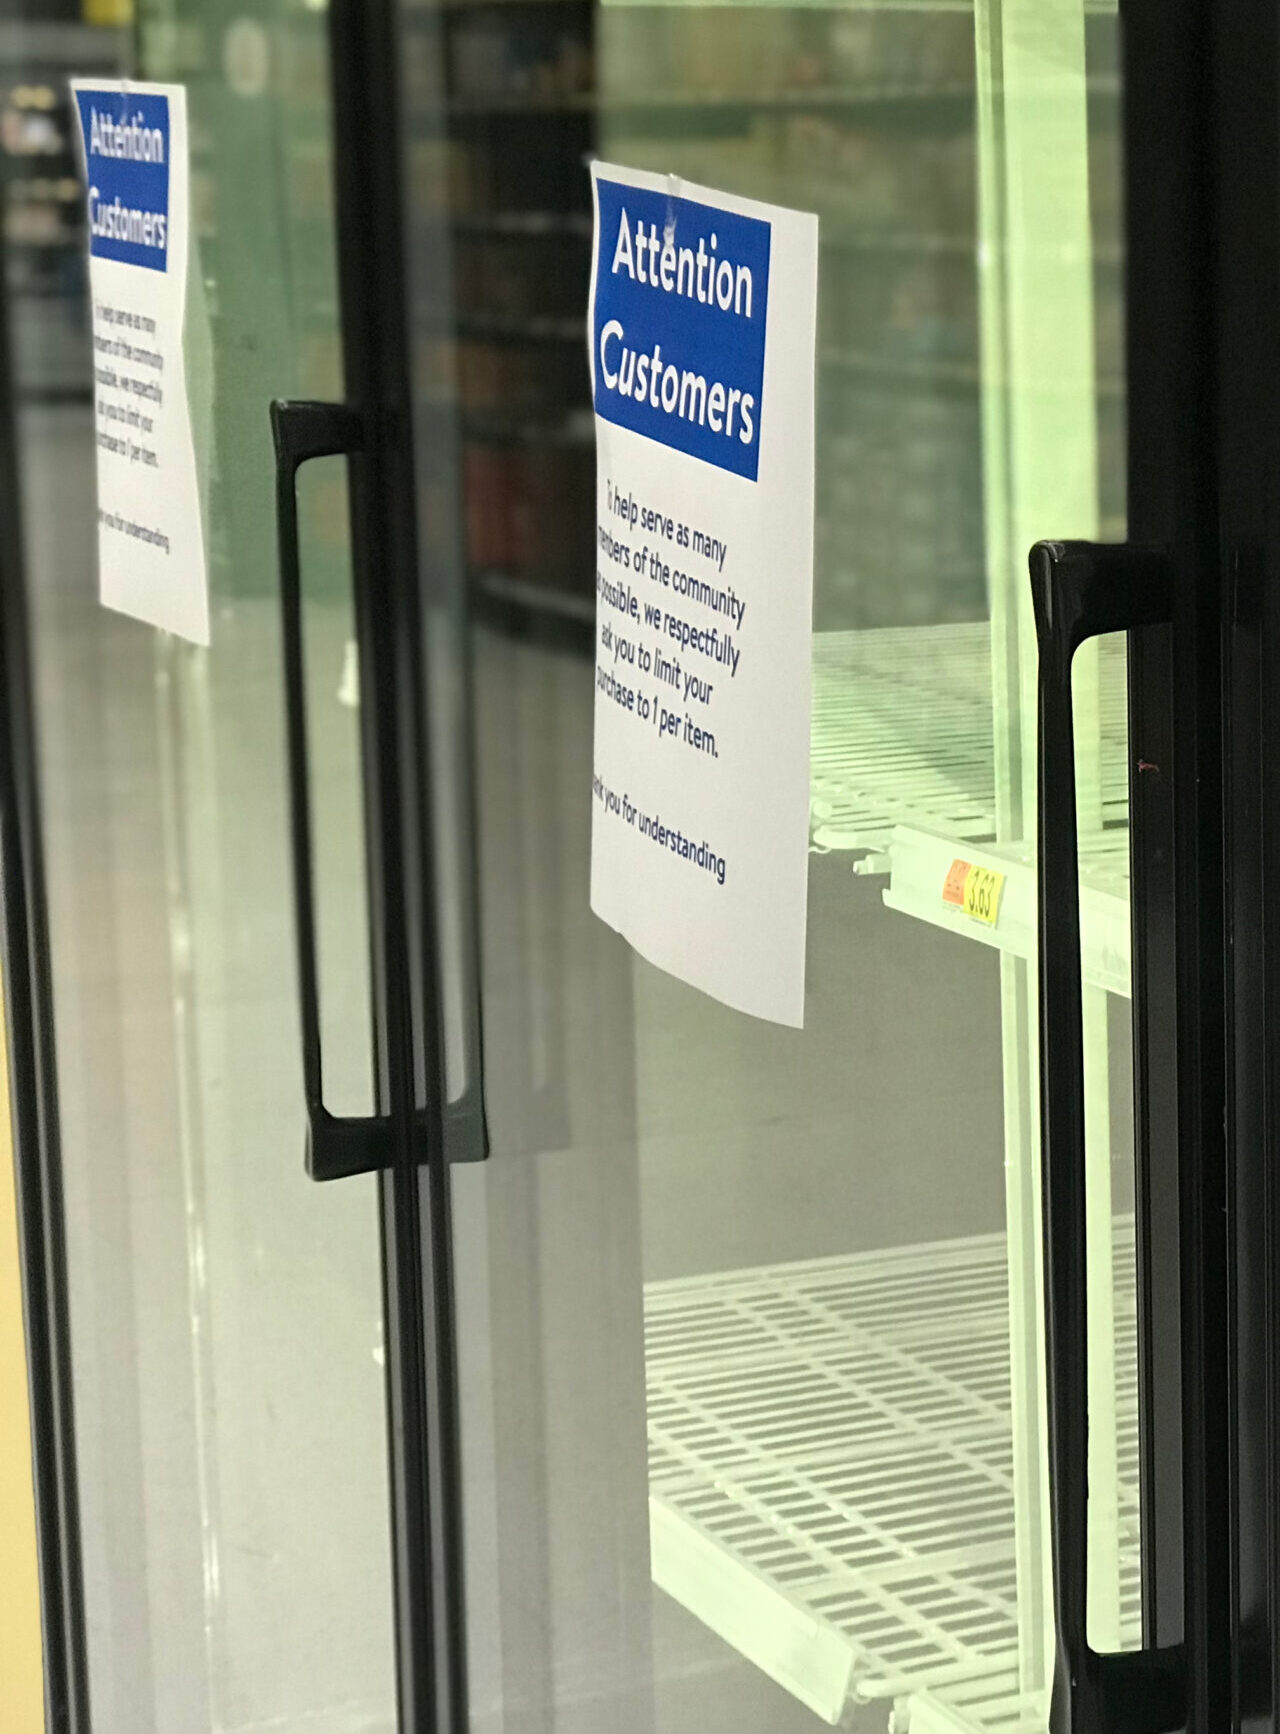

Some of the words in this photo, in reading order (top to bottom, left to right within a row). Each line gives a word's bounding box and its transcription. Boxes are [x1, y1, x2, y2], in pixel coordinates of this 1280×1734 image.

[90, 105, 164, 163] Attention
[88, 186, 166, 250] Customers
[612, 206, 752, 318] Attention
[600, 320, 754, 444] Customers
[614, 485, 638, 531] help
[641, 506, 674, 540] serve
[676, 522, 690, 548] as
[692, 529, 727, 573] many
[633, 545, 649, 576] of
[649, 551, 670, 587] the
[672, 569, 746, 631] community
[614, 635, 635, 664] you
[638, 642, 651, 673] to
[653, 647, 682, 690] limit
[683, 671, 713, 706] your
[643, 602, 662, 630] we
[663, 612, 740, 678] respectfully
[637, 689, 650, 720] to
[652, 695, 659, 725] 1
[659, 708, 682, 738] per
[683, 712, 719, 758] item.
[604, 786, 621, 814] you
[622, 793, 638, 826] for
[638, 815, 726, 885] understanding
